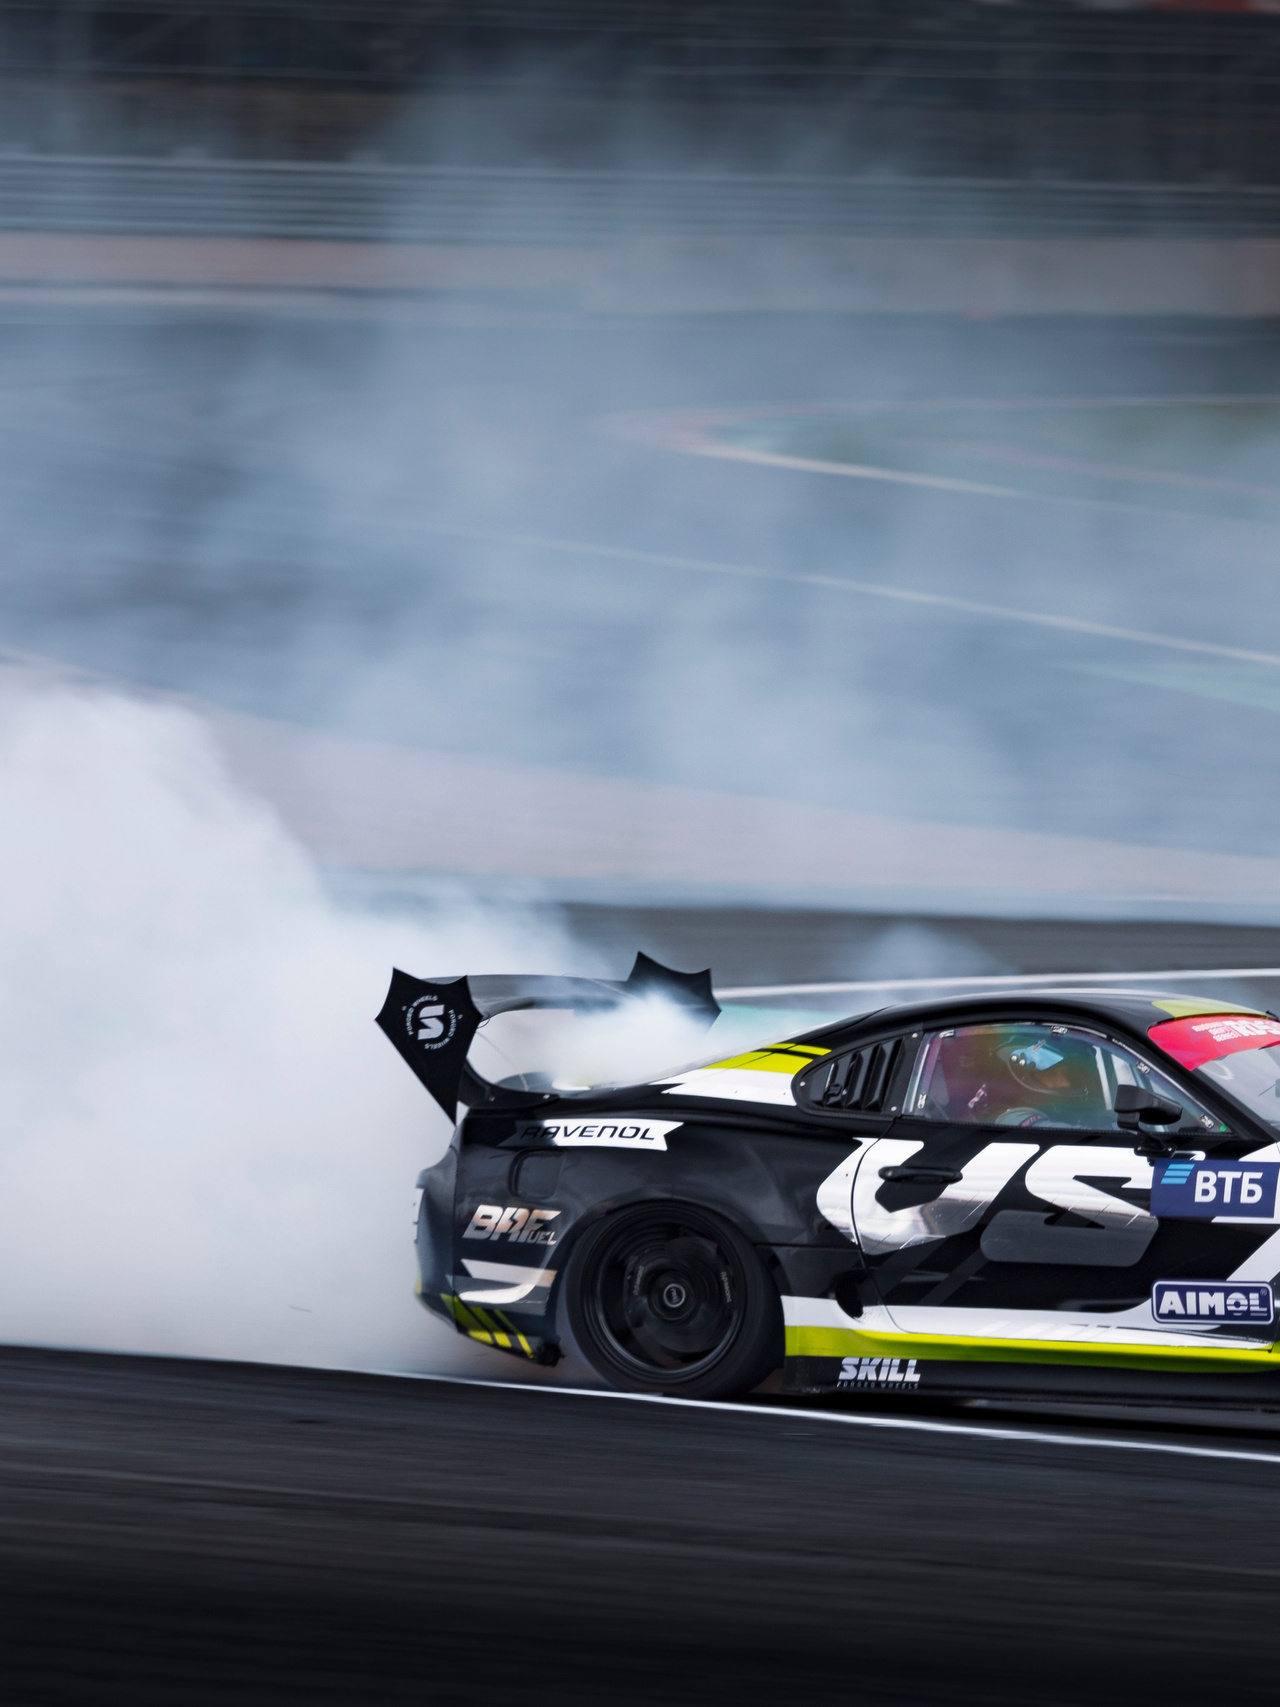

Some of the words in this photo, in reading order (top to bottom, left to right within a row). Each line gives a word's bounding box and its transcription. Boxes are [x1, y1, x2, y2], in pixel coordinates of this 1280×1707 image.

[519, 1125, 655, 1141] RAVENOL
[1194, 1170, 1264, 1204] ВТБ
[1158, 1291, 1268, 1316] AIMOL
[838, 1356, 921, 1382] SKILL
[836, 1381, 876, 1389] FORGED
[880, 1382, 919, 1390] WHEELS
